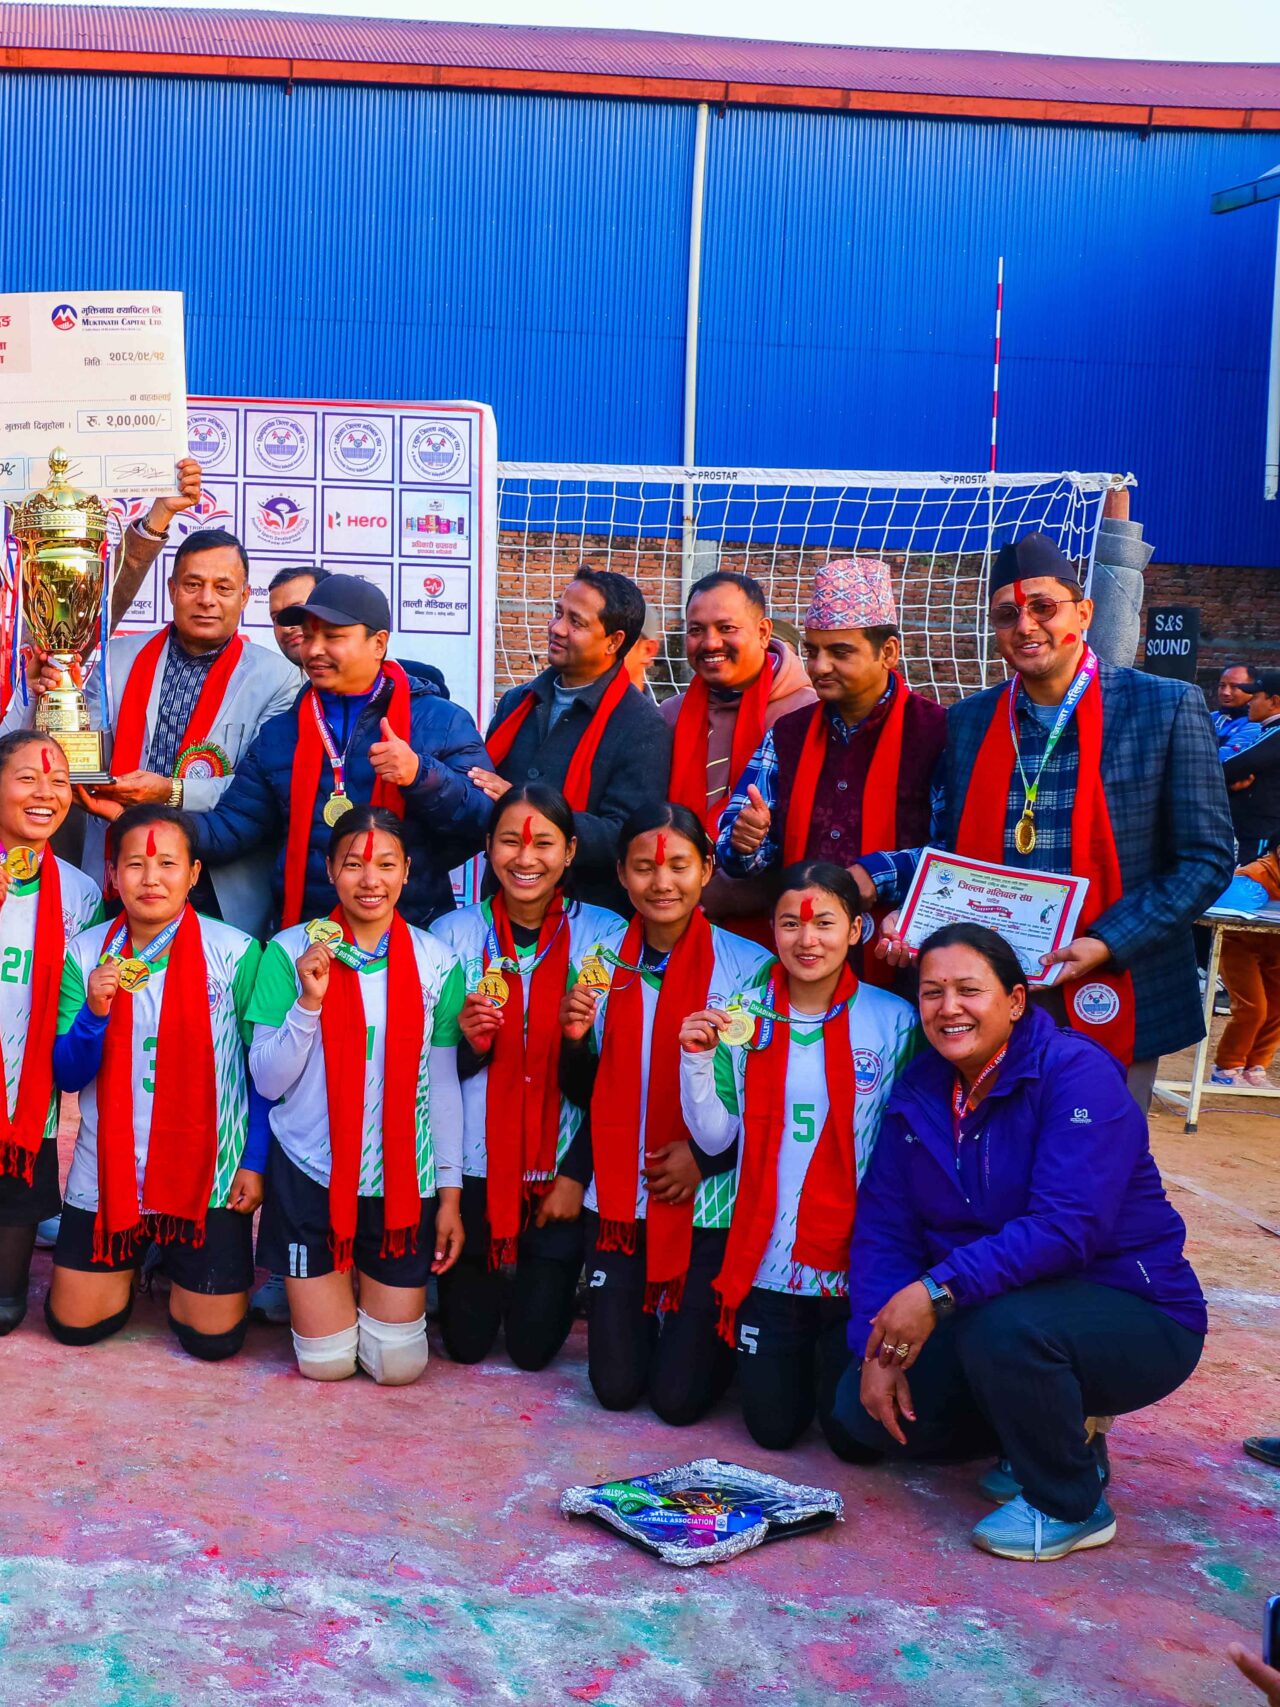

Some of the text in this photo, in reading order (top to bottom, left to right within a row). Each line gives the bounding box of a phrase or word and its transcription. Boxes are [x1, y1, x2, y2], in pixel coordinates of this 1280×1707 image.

[698, 470, 737, 481] PROSTAR
[953, 475, 986, 484] PROSTA
[347, 515, 387, 528] Hero
[1155, 614, 1183, 632] S&S
[1146, 638, 1191, 656] SOUND
[1050, 708, 1069, 739] जिल्ला
[1065, 670, 1090, 706] भलिबल
[958, 880, 1033, 903] जिल्ला भलिबल संघ
[144, 931, 171, 957] VOLLEYBALL
[0, 947, 32, 985] 21
[338, 949, 360, 968] DISTRICT
[750, 1003, 777, 1021] DHADING
[792, 1103, 815, 1143] 5
[288, 1243, 308, 1278] 11
[590, 1270, 607, 1288] 2
[669, 1518, 714, 1526] ASSOCIATION
